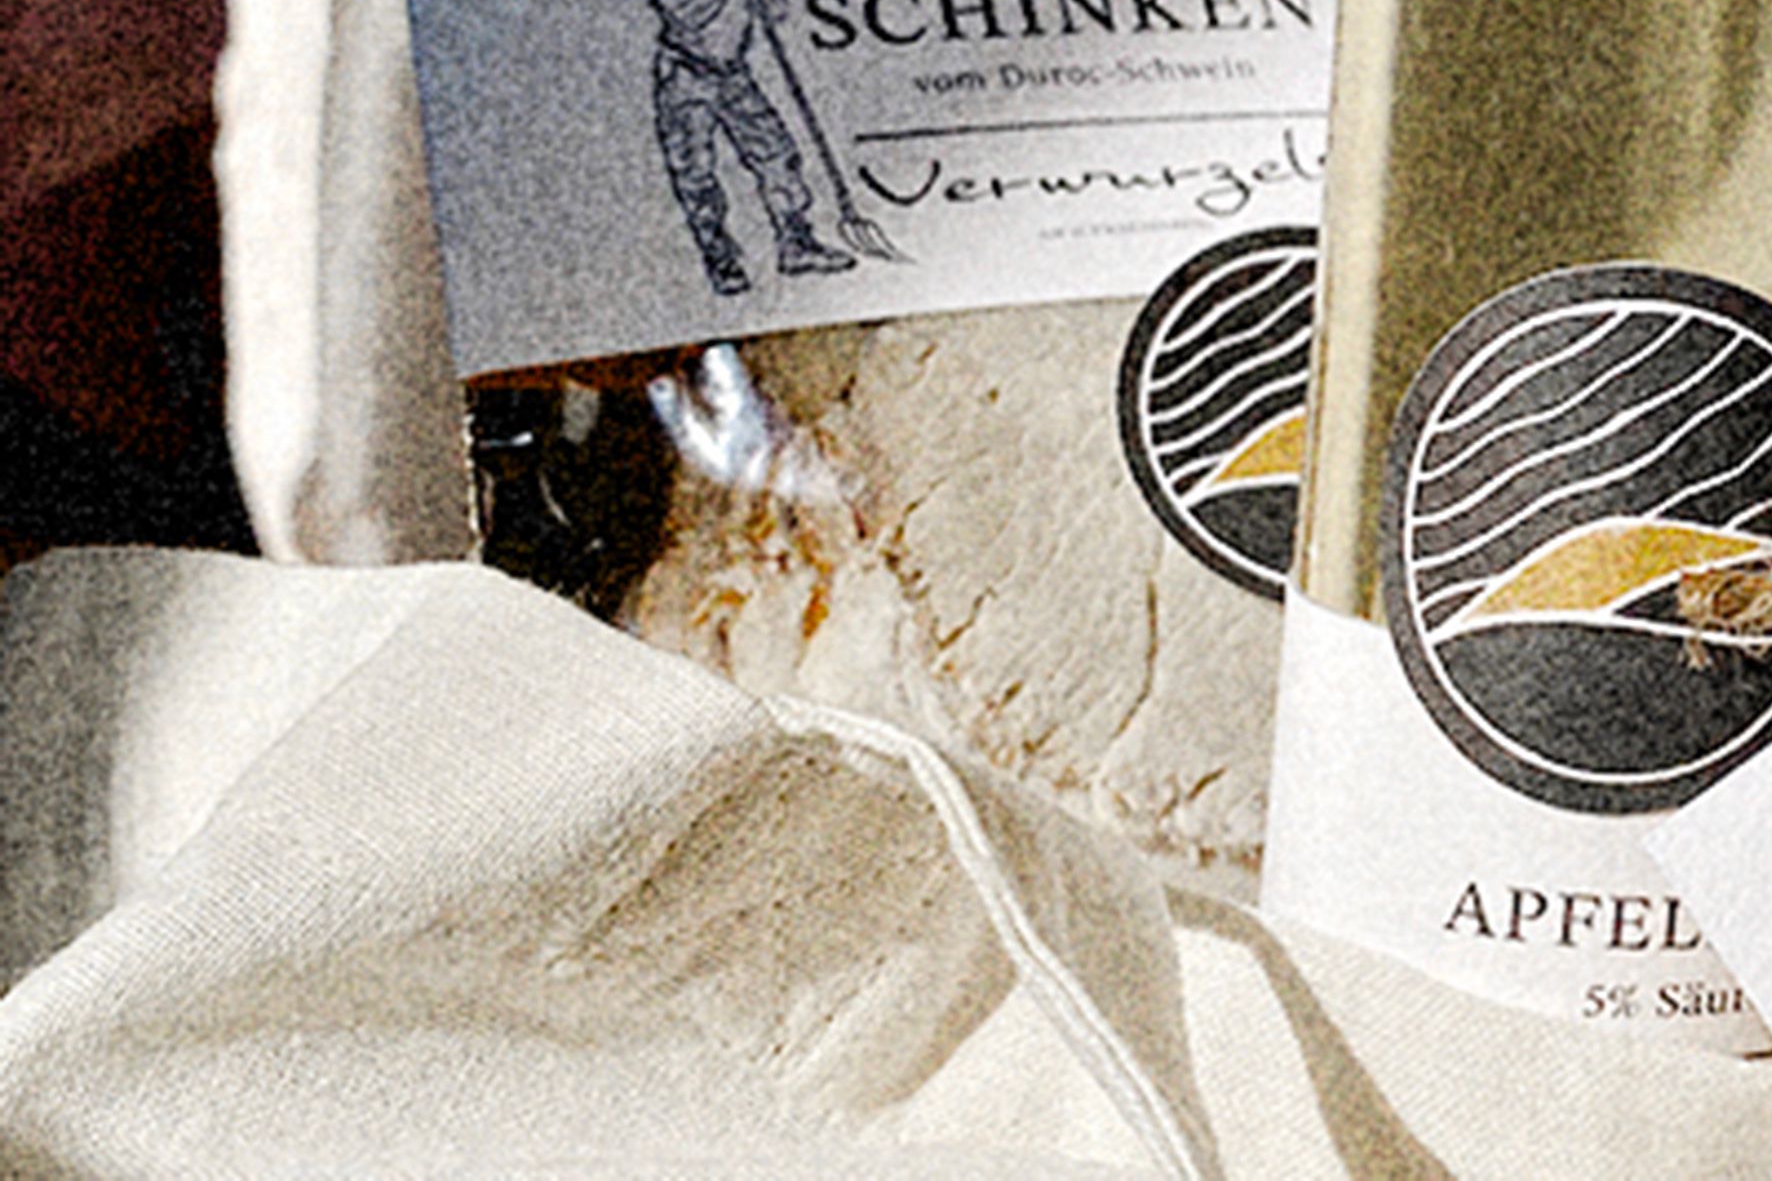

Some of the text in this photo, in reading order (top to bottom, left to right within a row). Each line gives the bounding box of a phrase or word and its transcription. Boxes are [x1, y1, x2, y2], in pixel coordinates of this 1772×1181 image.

[913, 71, 987, 94] vom
[857, 128, 1326, 217] Verwurzel
[1444, 882, 1702, 951] APFEL
[1583, 983, 1641, 1018] 5%
